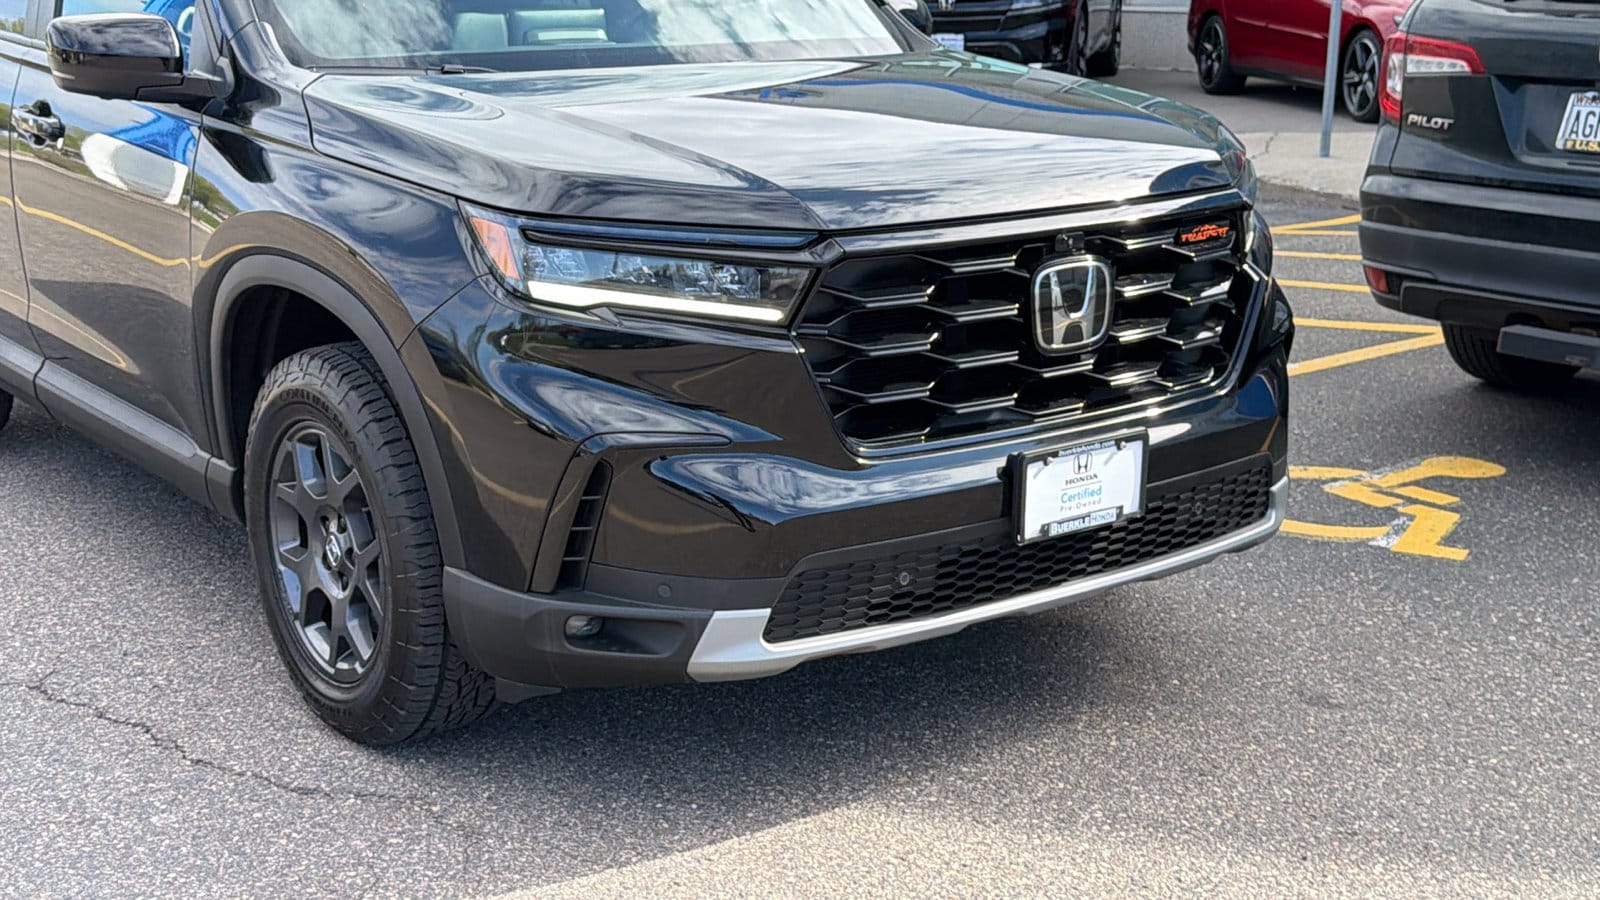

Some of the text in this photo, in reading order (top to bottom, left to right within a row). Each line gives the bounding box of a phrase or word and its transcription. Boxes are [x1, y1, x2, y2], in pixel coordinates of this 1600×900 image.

[1407, 114, 1454, 130] PILOT
[1065, 474, 1098, 486] HONDA
[1061, 485, 1102, 504] Certified
